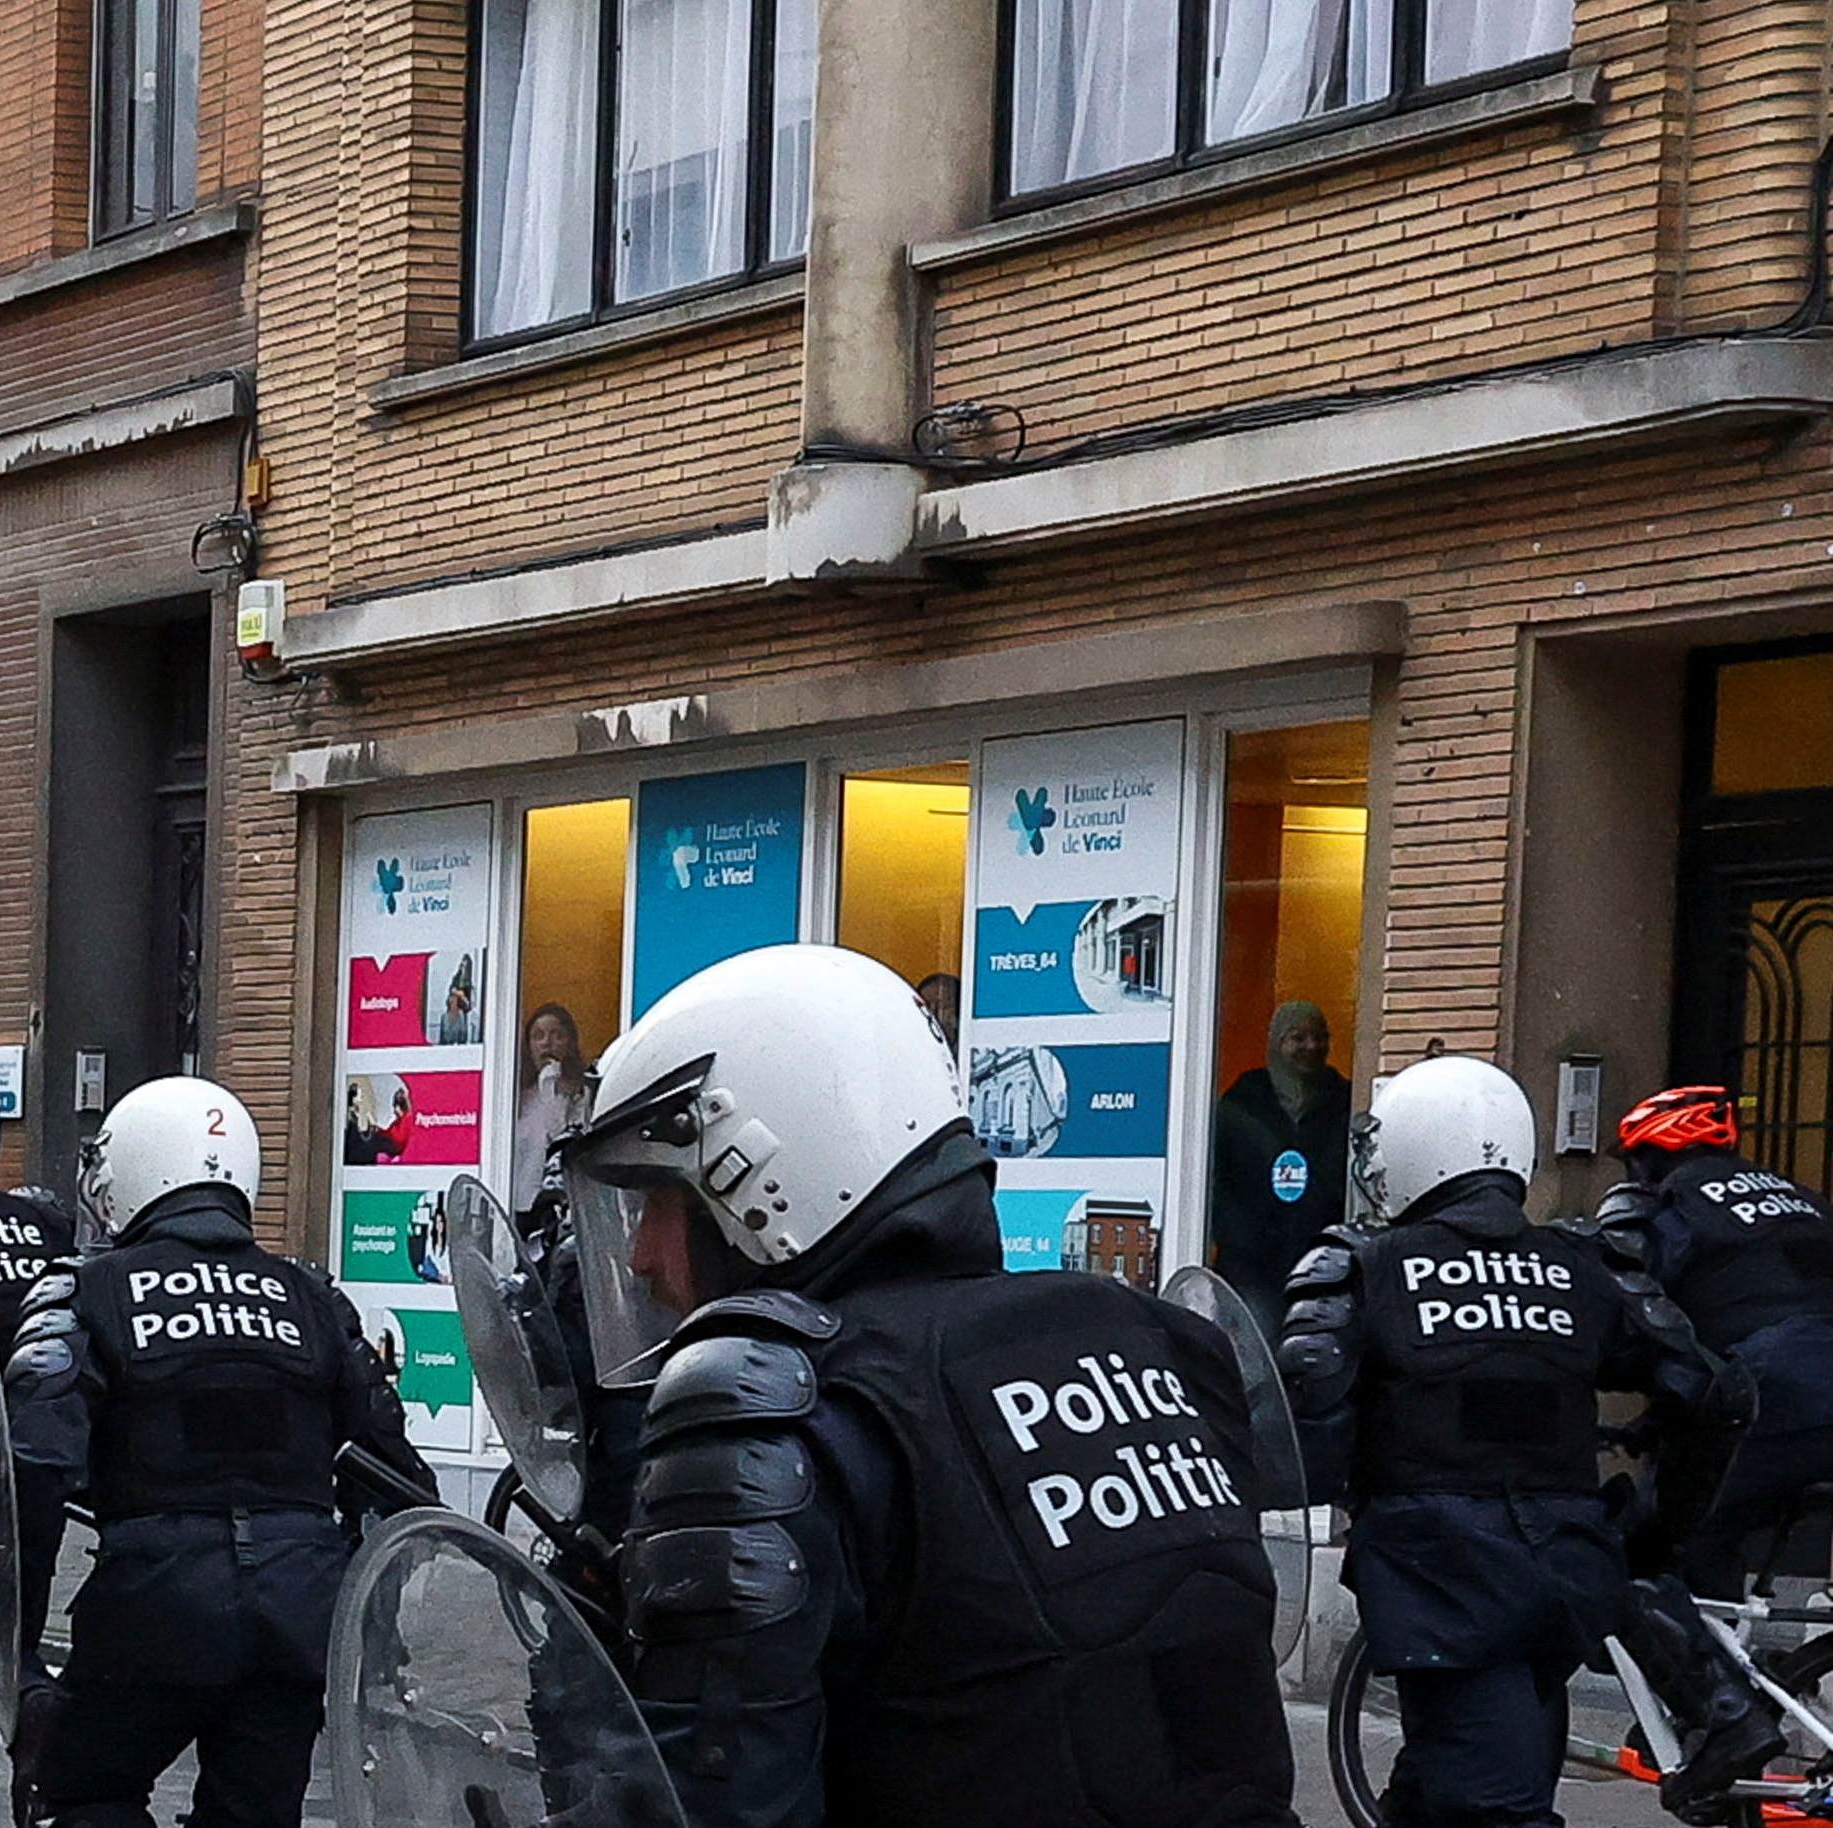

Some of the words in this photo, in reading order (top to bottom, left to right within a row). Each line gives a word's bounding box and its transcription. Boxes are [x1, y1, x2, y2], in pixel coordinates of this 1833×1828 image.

[1083, 830, 1123, 852] Vinci
[206, 1109, 226, 1136] 2
[130, 1263, 288, 1303] Police
[1402, 1250, 1572, 1291] Politie
[132, 1303, 302, 1348] Politie
[1418, 1293, 1574, 1336] Police
[991, 1353, 1199, 1452] Police
[1027, 1437, 1242, 1548] Politie
